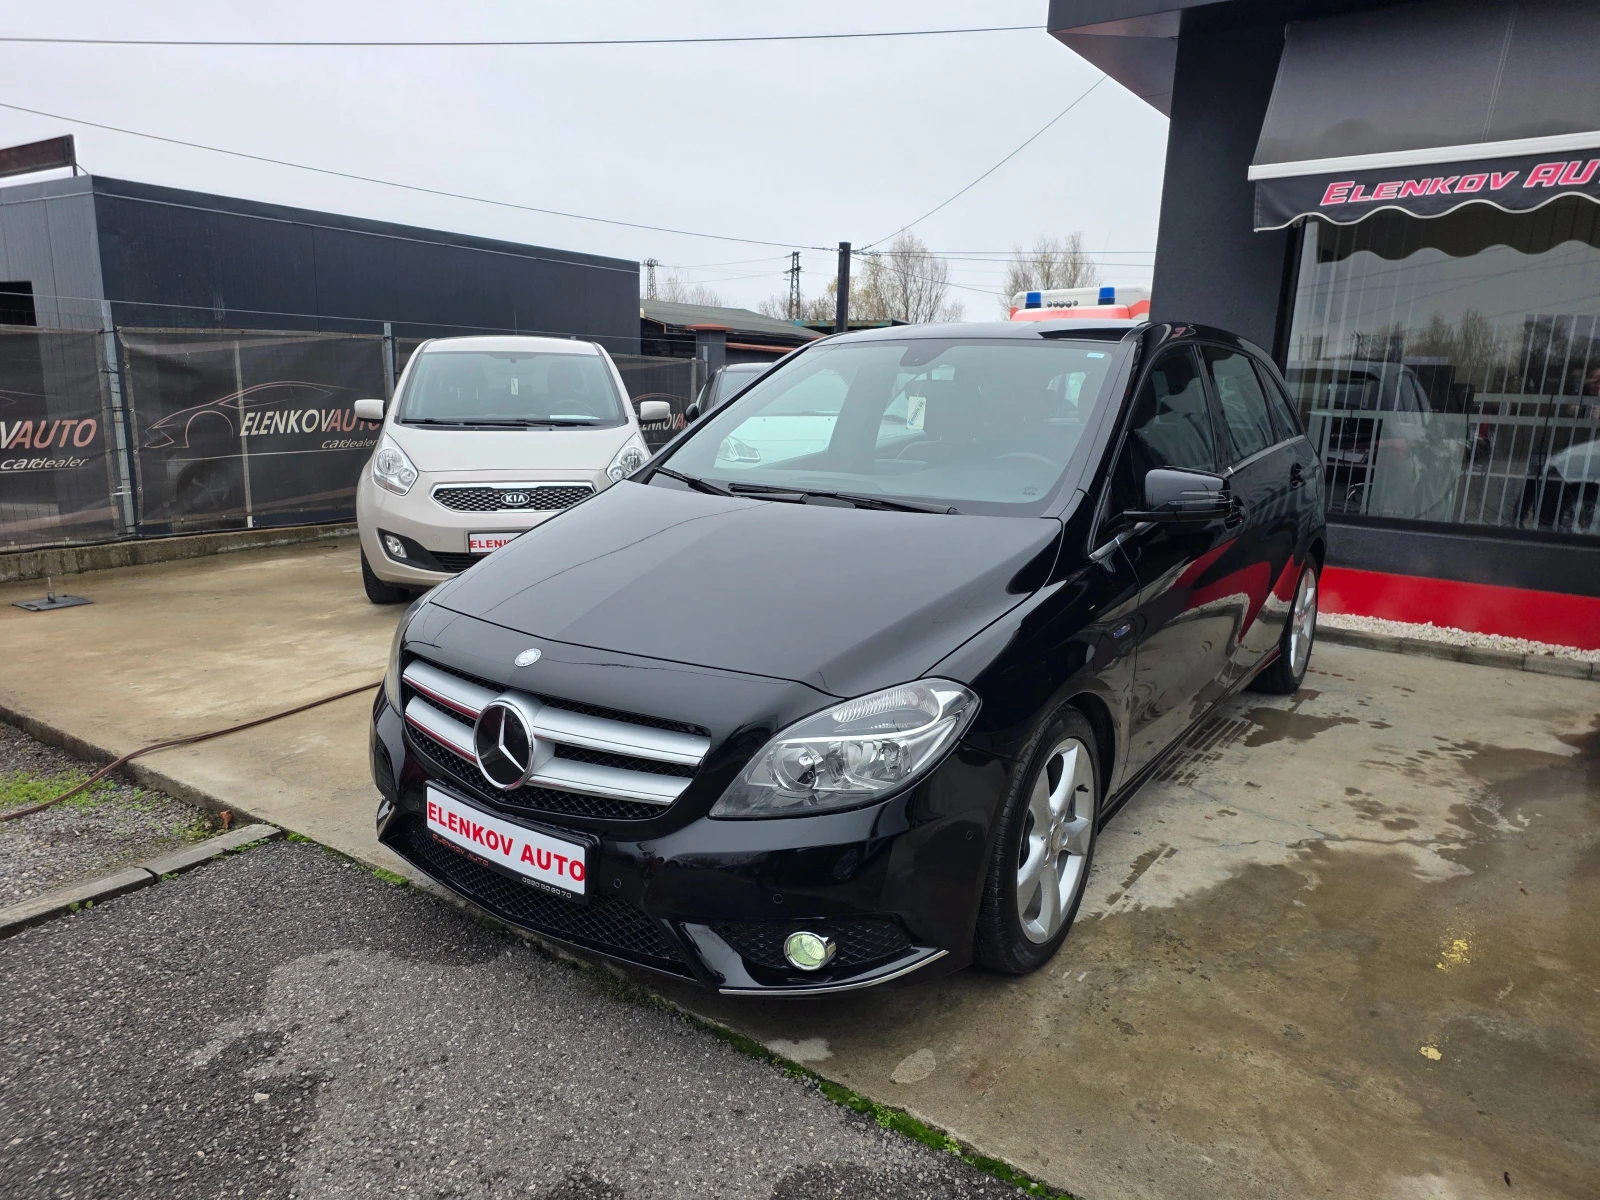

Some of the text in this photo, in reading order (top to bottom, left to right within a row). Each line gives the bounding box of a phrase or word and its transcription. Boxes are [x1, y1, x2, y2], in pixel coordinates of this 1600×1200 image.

[1320, 158, 1600, 206] ELENKOV AU
[1, 456, 89, 470] cardealer
[505, 494, 525, 503] KIA
[428, 801, 585, 882] ELENKOV AUTO
